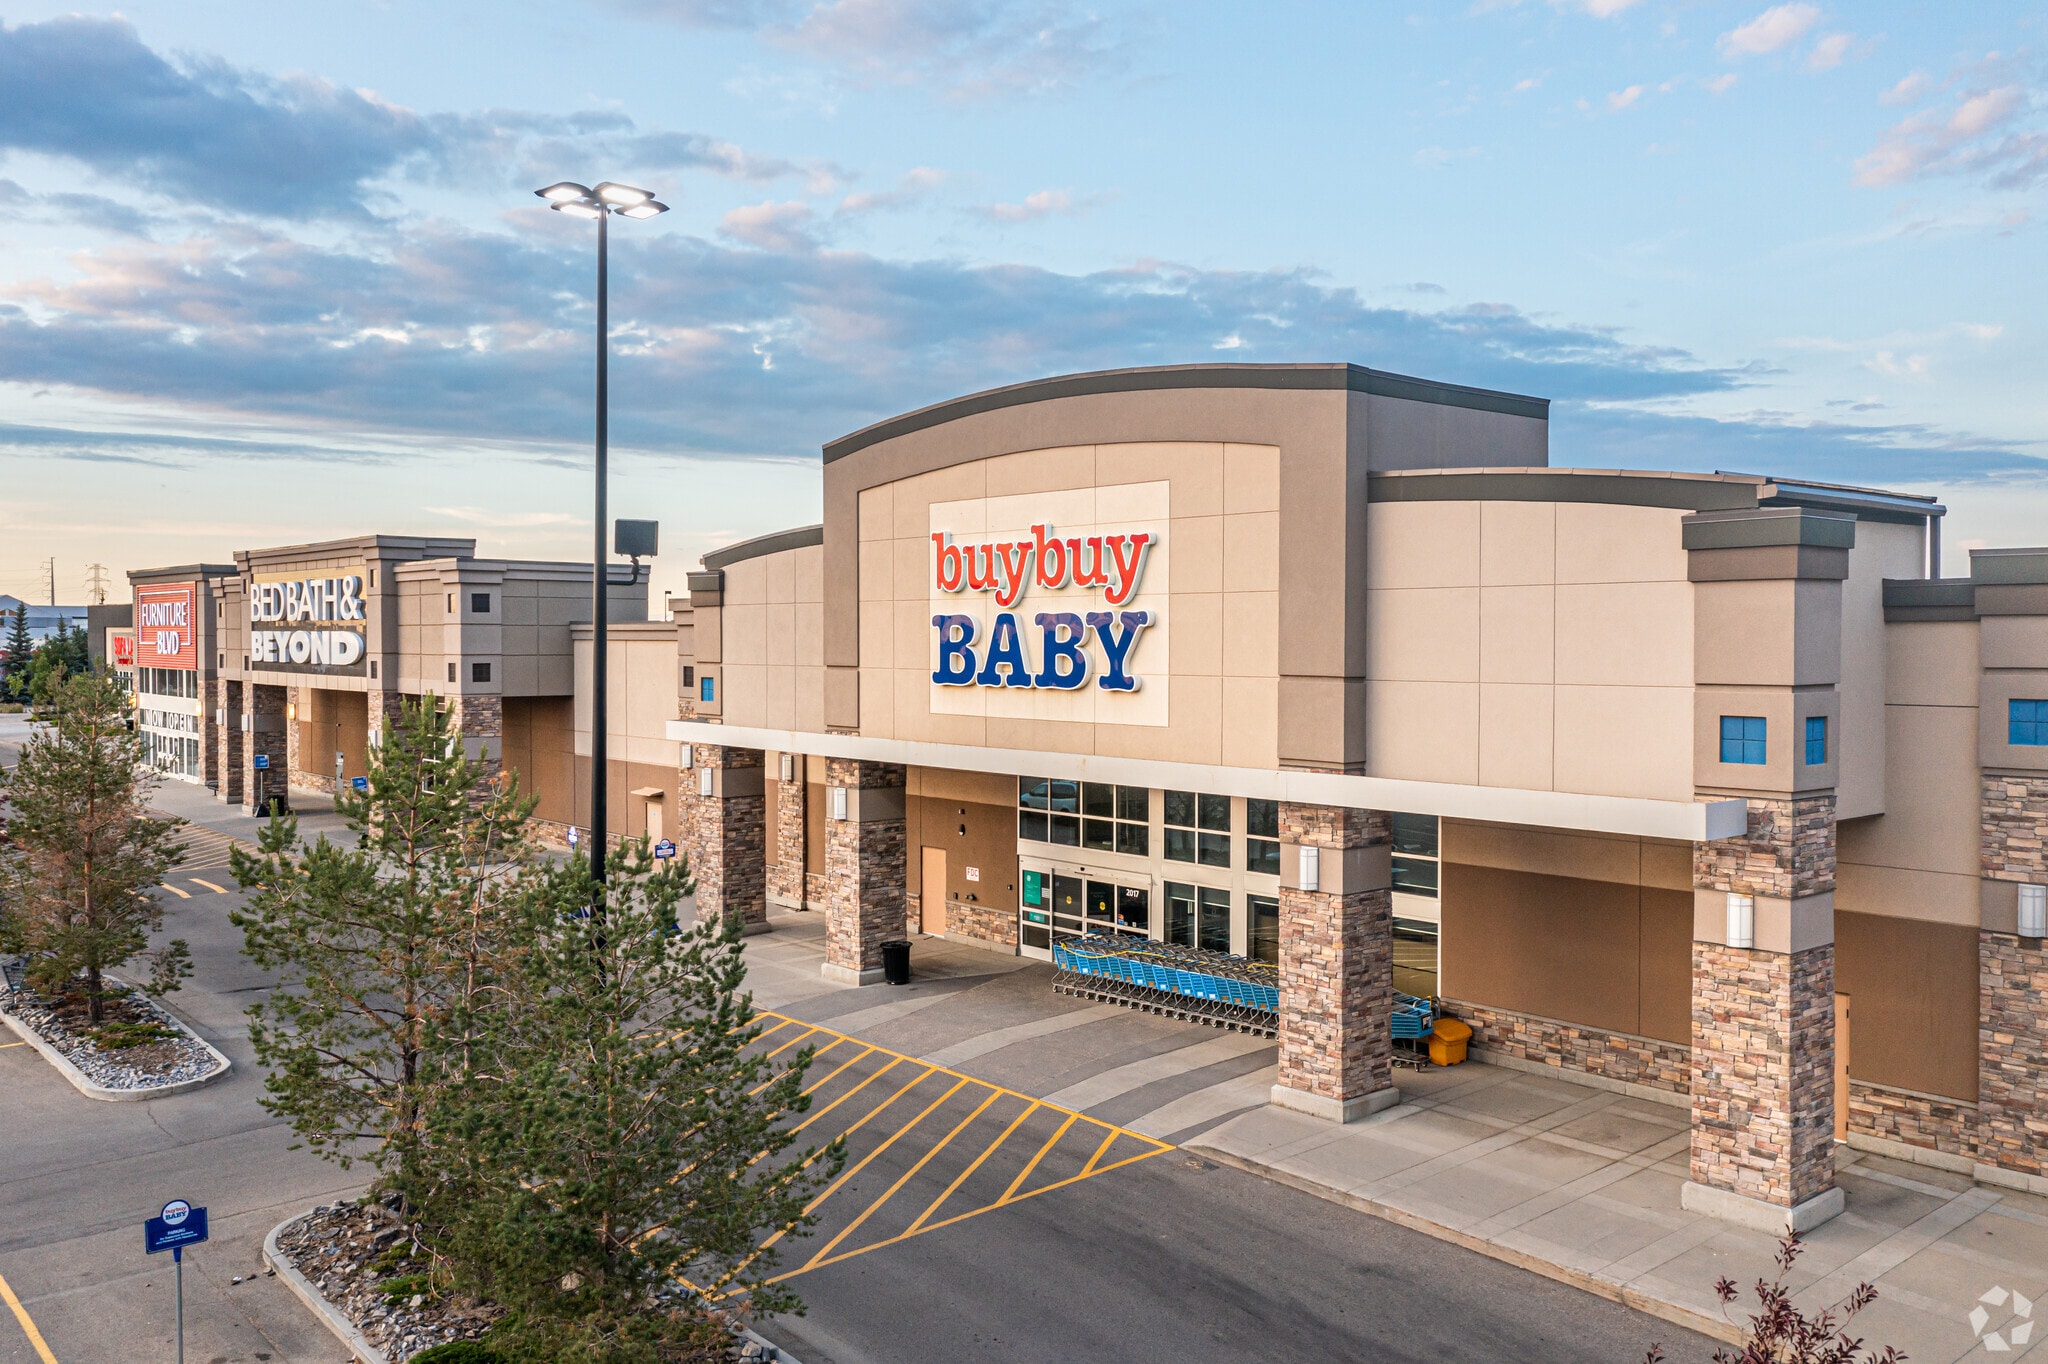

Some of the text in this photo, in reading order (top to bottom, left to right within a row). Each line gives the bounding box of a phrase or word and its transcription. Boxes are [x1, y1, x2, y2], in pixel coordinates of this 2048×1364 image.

[932, 522, 1154, 607] buybuy
[251, 576, 364, 622] BED BATH &
[142, 602, 187, 626] FURNITURE
[157, 631, 180, 655] BLVD
[251, 630, 364, 665] BEYOND
[932, 612, 1154, 692] BABY
[145, 708, 193, 732] NOW OPEN
[1126, 888, 1139, 898] 2017
[165, 1211, 187, 1220] BABY
